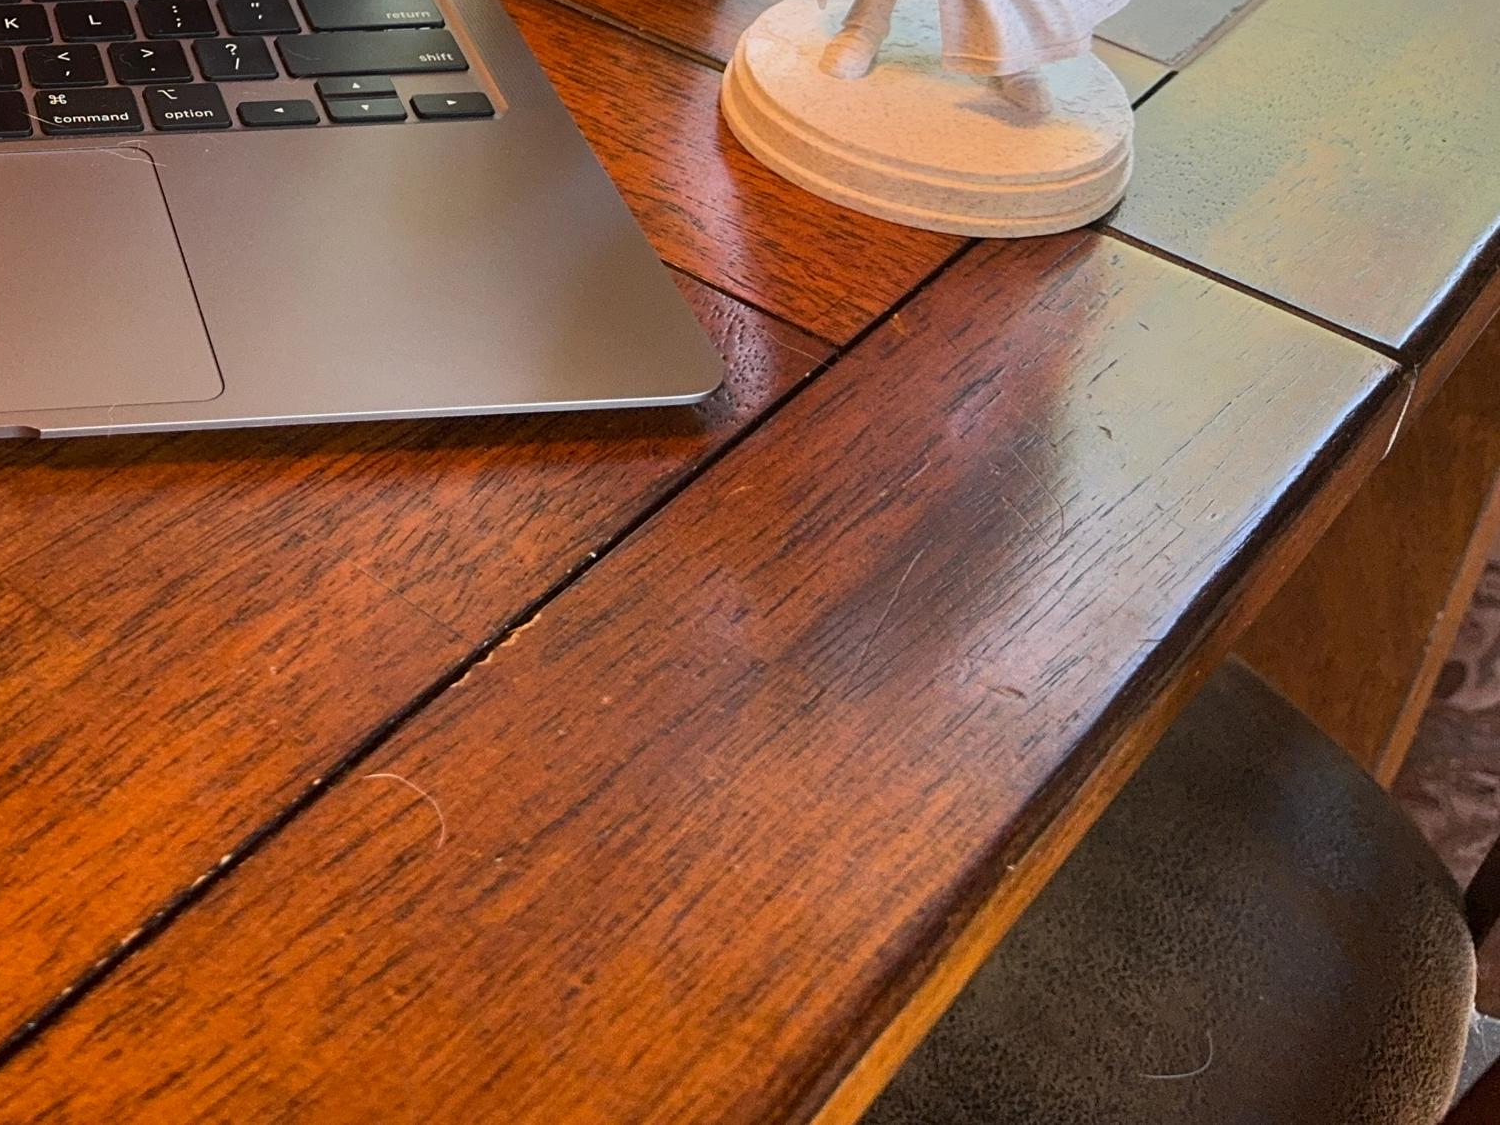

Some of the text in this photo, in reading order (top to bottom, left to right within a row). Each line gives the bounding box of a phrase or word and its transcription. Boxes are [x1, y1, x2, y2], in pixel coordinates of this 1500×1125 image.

[5, 18, 19, 28] K
[89, 15, 101, 25] L
[419, 53, 453, 61] shift
[54, 113, 129, 123] command
[165, 110, 213, 119] option
